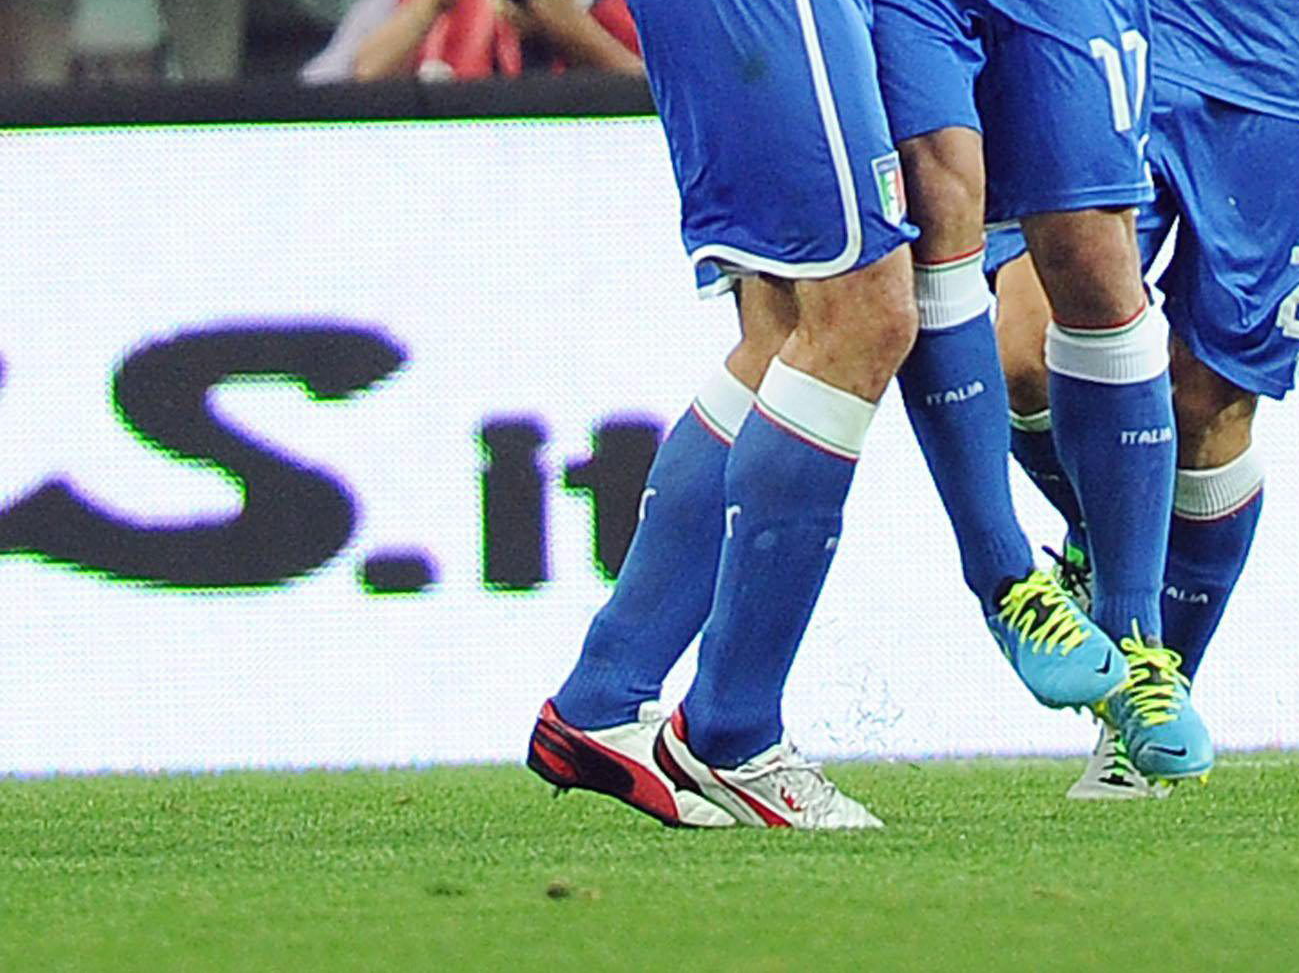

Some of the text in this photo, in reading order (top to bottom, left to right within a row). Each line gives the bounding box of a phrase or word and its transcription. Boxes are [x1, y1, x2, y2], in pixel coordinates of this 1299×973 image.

[1088, 28, 1149, 132] 17
[926, 380, 985, 406] ITALIA
[1121, 427, 1173, 445] ITALIA
[1165, 586, 1209, 604] ALIA
